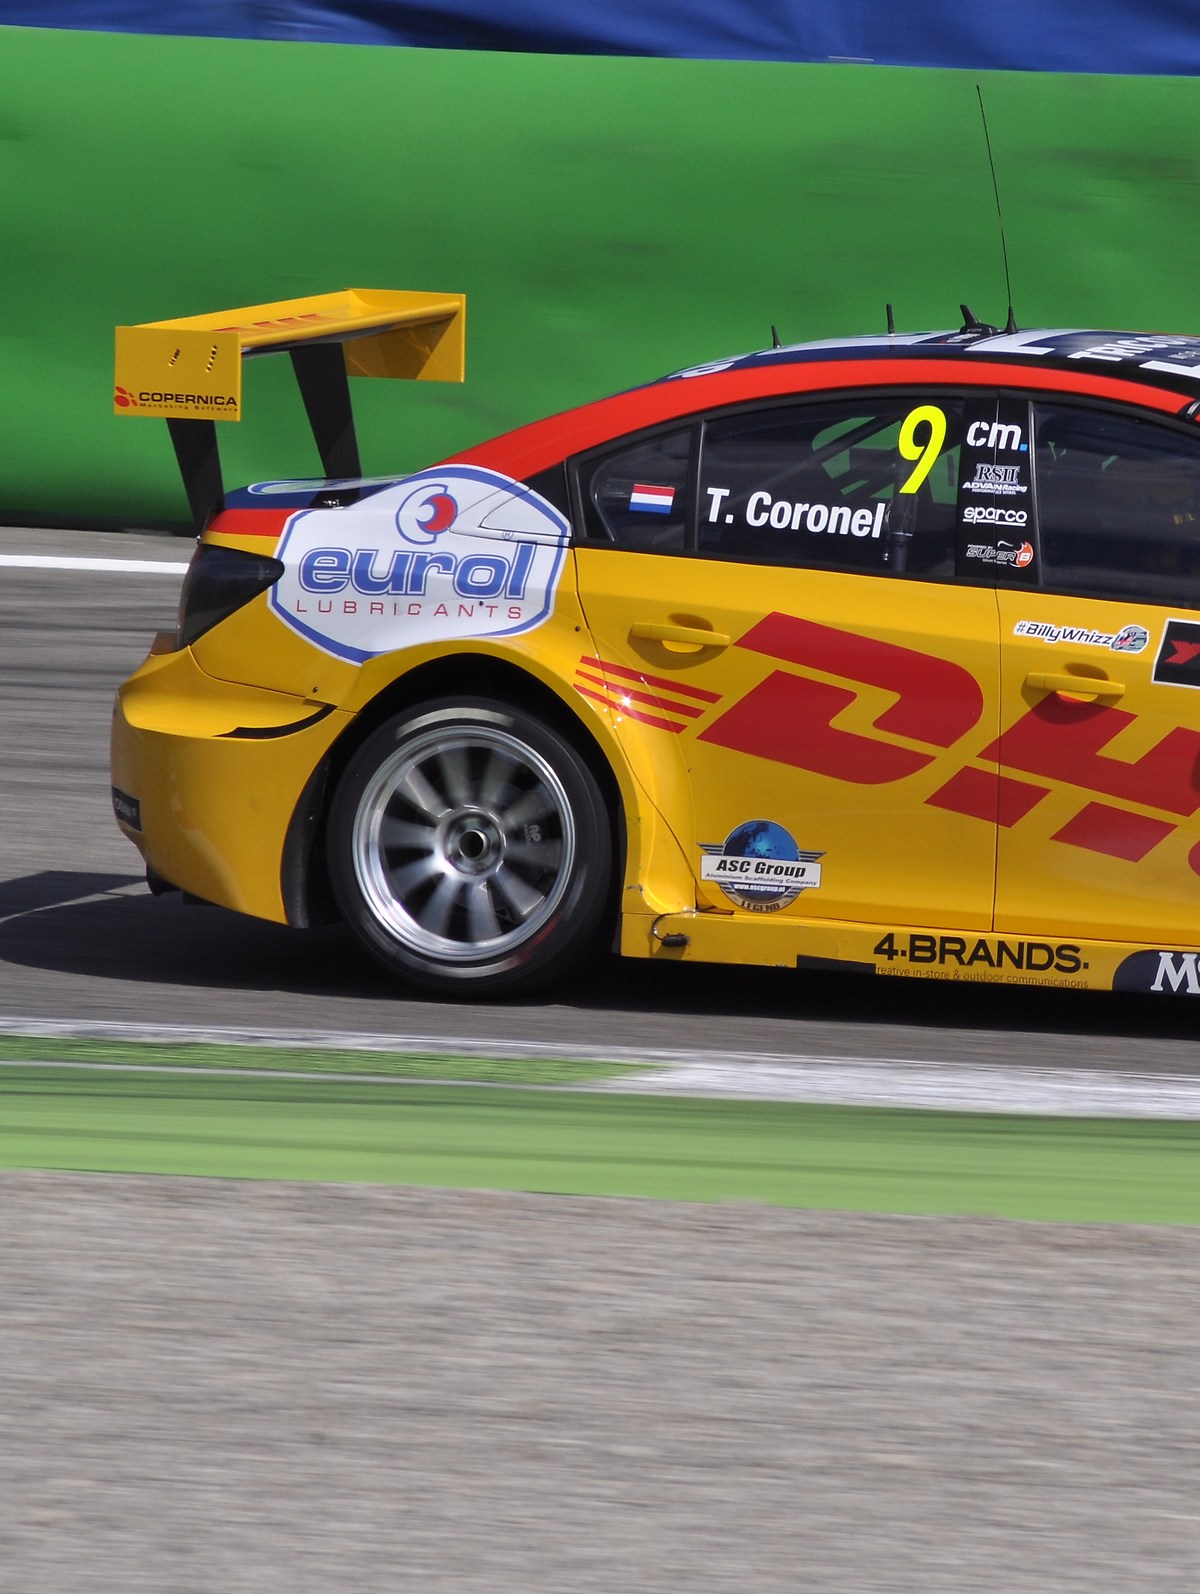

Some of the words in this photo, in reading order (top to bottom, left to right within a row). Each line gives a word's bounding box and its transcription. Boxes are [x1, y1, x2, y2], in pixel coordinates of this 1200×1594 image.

[139, 392, 238, 406] COPERNICA
[898, 404, 947, 494] 9
[962, 481, 1003, 492] ADVAN
[1003, 484, 1028, 493] Racing
[707, 487, 734, 525] T.
[746, 491, 887, 539] Coronel
[963, 506, 1028, 525] sparco
[966, 547, 1017, 562] SUPER
[299, 540, 538, 601] eurol
[296, 600, 522, 620] LUBRICANTS
[1016, 622, 1114, 645] #BillyWhizz
[716, 859, 751, 873] ASC
[754, 861, 807, 878] Group
[785, 878, 818, 887] Company
